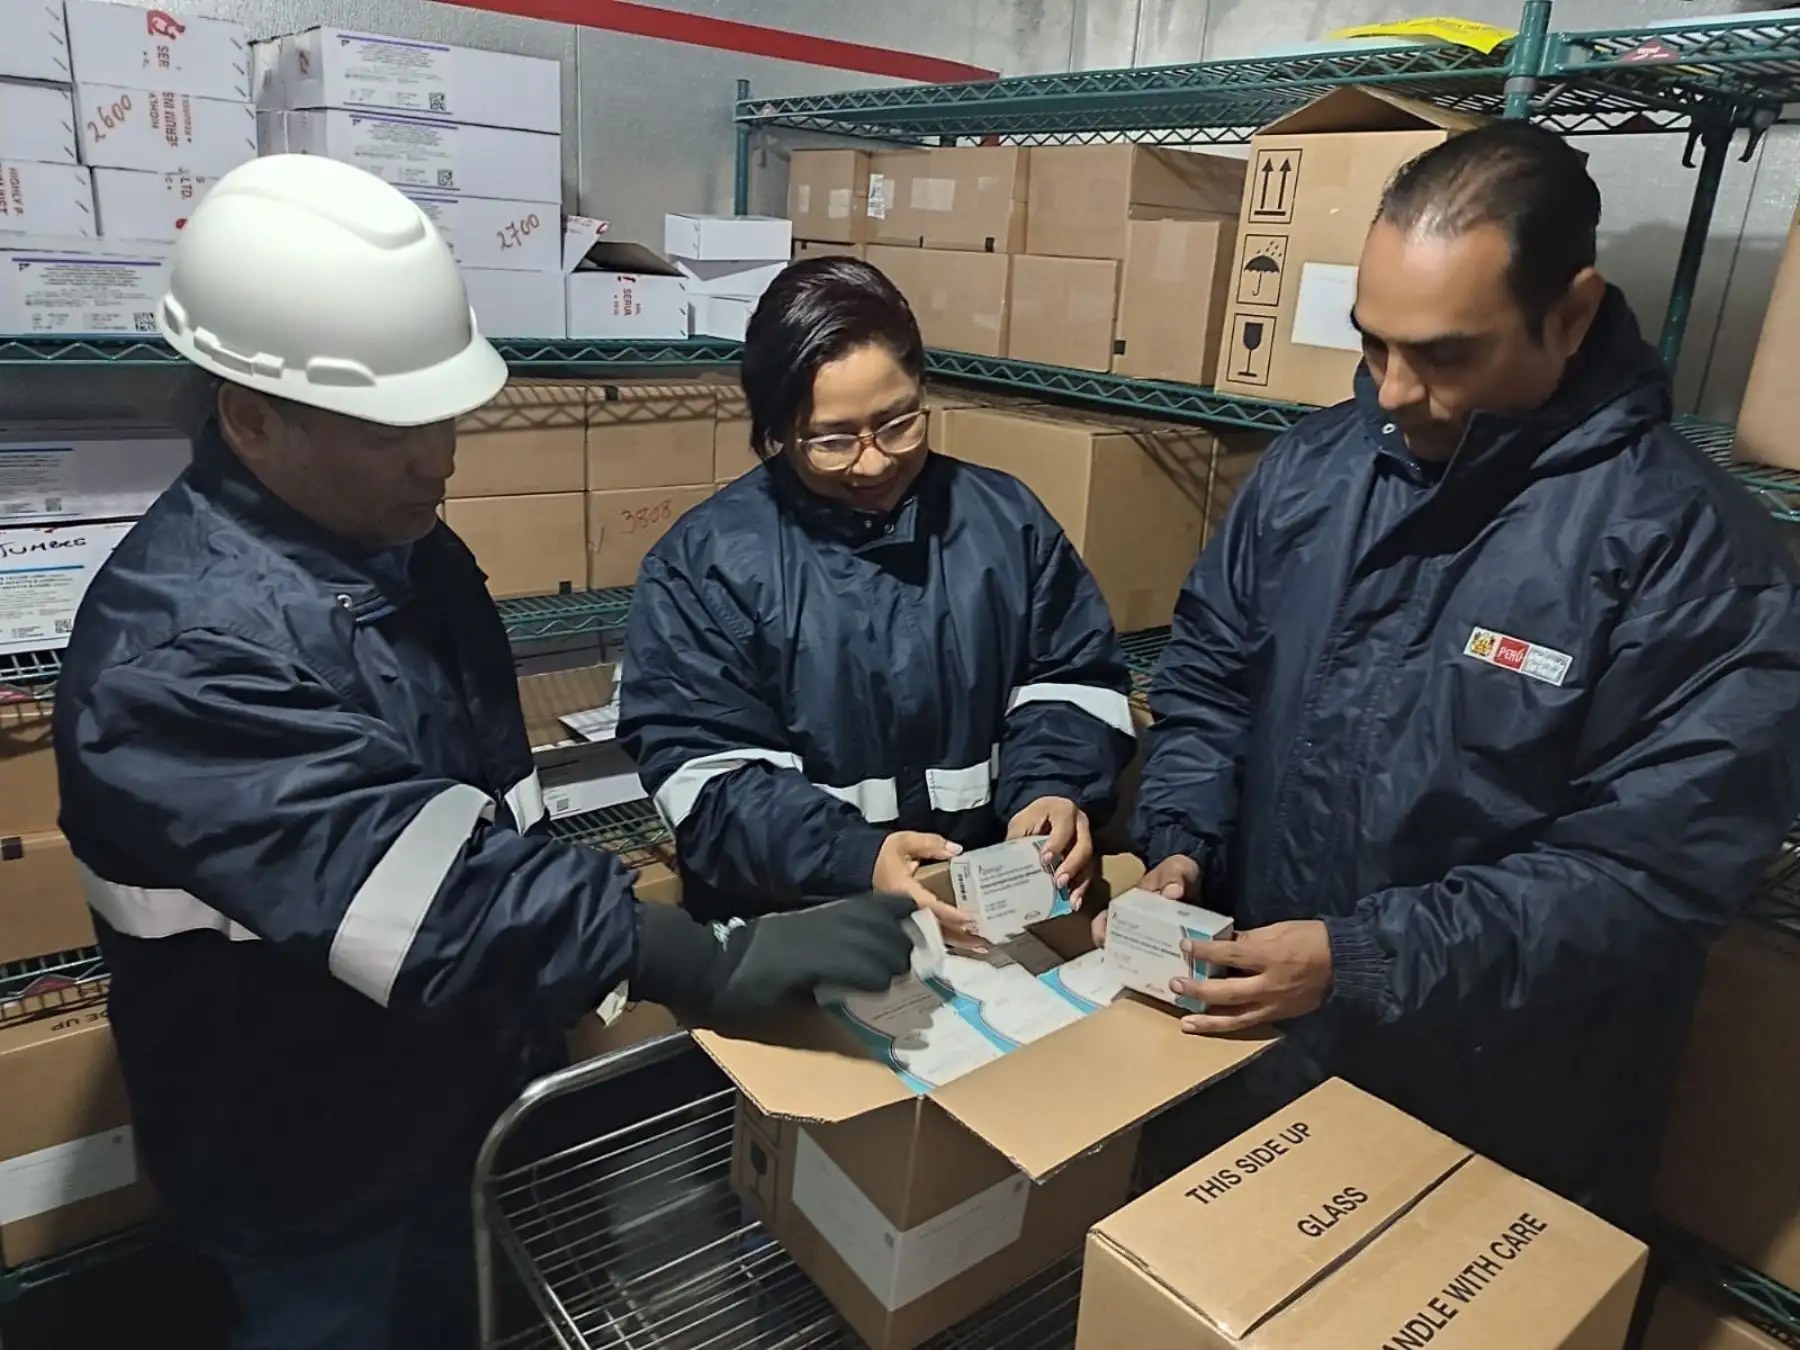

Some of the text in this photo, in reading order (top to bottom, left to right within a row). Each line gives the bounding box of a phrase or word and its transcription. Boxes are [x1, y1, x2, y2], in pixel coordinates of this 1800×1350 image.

[87, 93, 132, 143] 2600
[496, 213, 540, 251] 2700
[51, 1018, 80, 1031] UP
[1184, 1121, 1312, 1205] THIS SIDE UP
[1296, 1186, 1369, 1238] GLASS
[1381, 1212, 1549, 1350] NDLE WITH CARE
